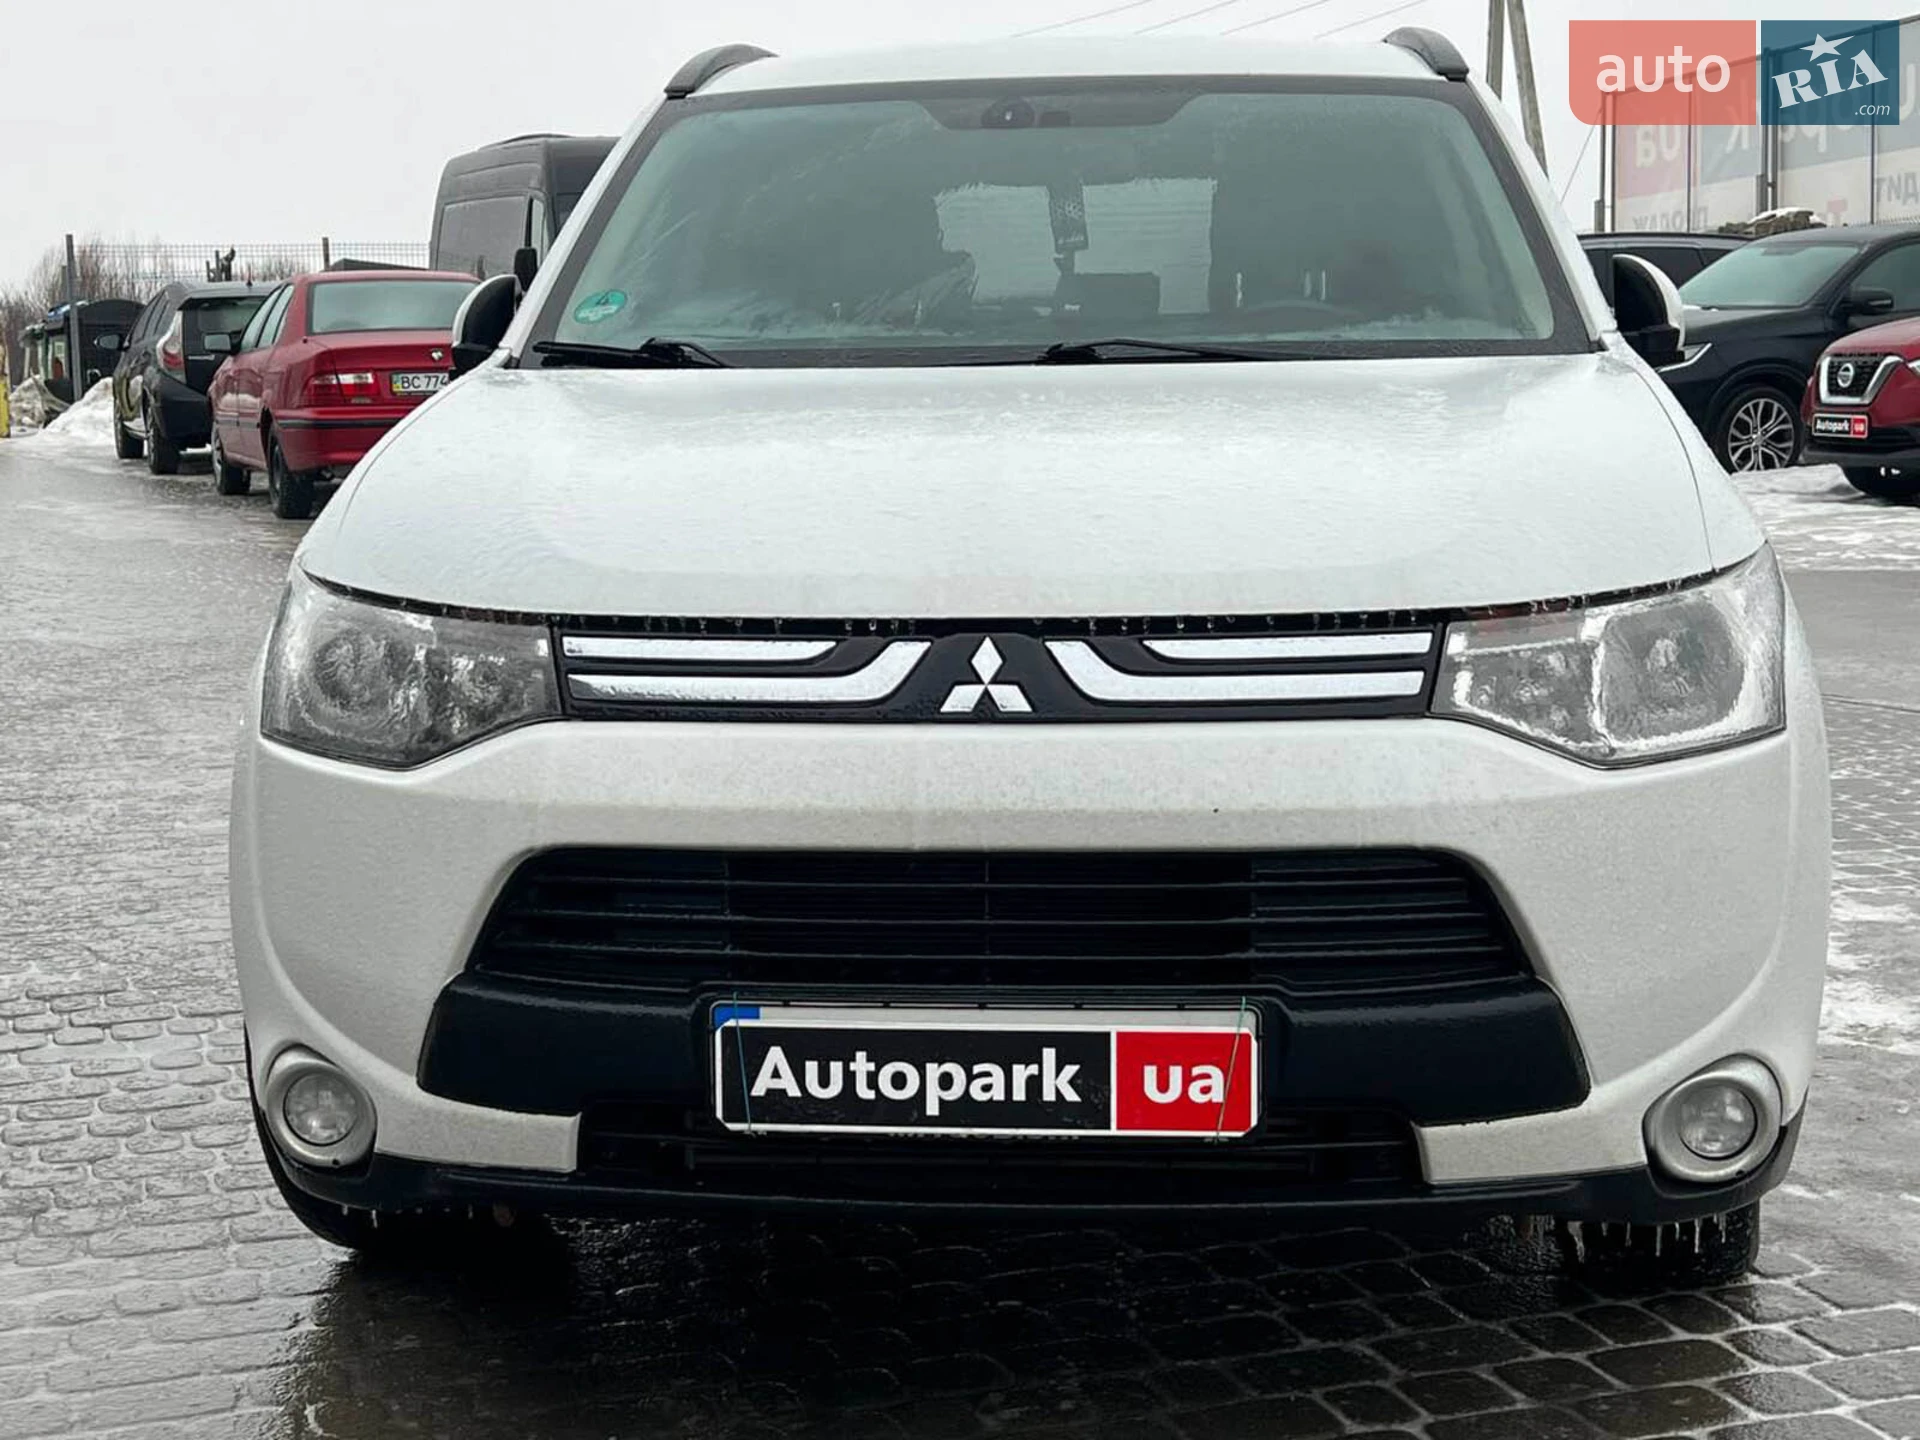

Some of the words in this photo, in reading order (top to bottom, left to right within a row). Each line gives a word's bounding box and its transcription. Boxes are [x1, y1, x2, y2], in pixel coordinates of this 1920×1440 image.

[401, 375, 422, 389] BC
[1815, 418, 1849, 432] Autopark
[750, 1045, 1082, 1116] Autopark
[1143, 1064, 1224, 1104] ua
